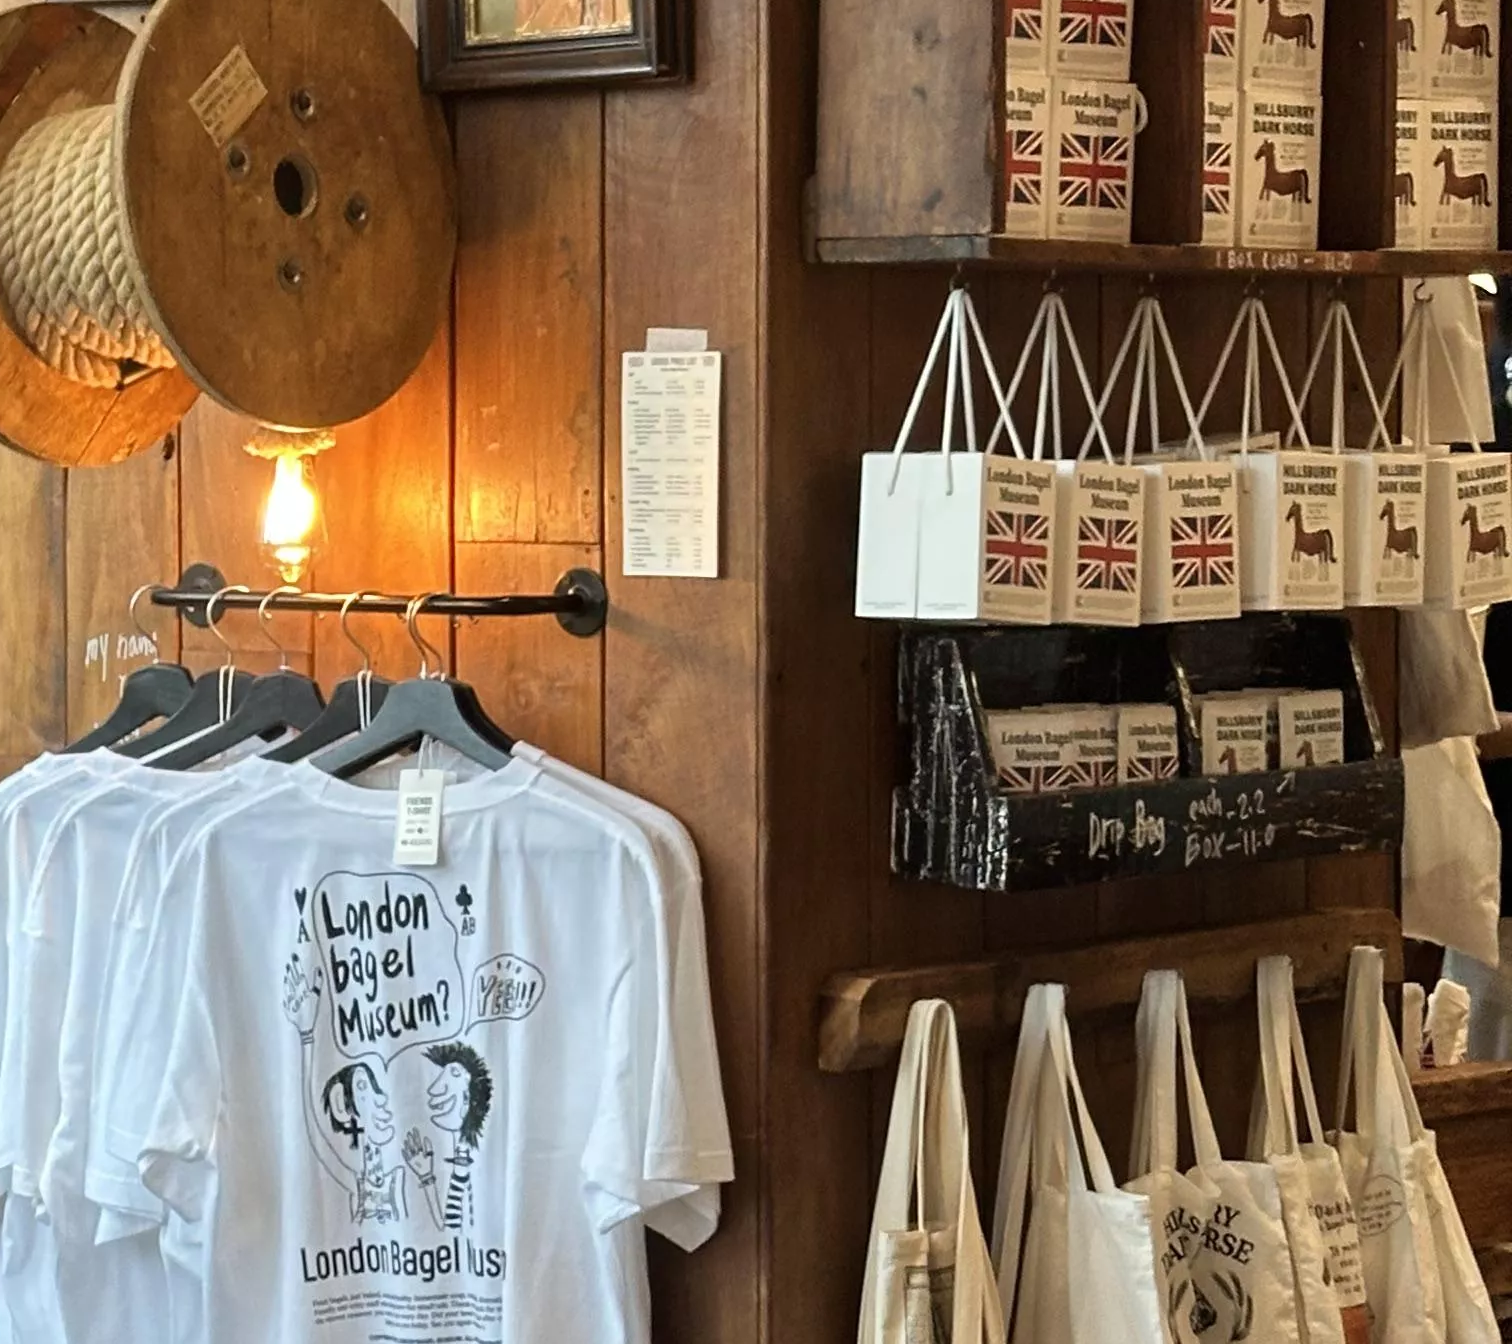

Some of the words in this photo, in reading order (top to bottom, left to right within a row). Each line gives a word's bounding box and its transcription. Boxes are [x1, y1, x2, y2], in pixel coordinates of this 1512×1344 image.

[1061, 90, 1101, 107] London
[1103, 93, 1131, 113] Bagel
[1253, 102, 1315, 118] HILLSBURRY
[1074, 109, 1118, 128] Museum
[1253, 120, 1281, 135] DARK
[1283, 122, 1315, 137] HORSE
[987, 466, 1023, 486] London
[1025, 471, 1051, 492] Bagel
[1079, 474, 1114, 492] London
[1115, 477, 1140, 496] Bagel
[1167, 475, 1205, 491] London
[1206, 472, 1232, 493] Bagel
[999, 486, 1040, 506] Museum
[1283, 482, 1305, 496] DARK
[1307, 482, 1337, 497] HORSE
[1457, 484, 1480, 500] DARK
[1481, 480, 1508, 497] HORSE
[1090, 492, 1129, 511] Museum
[1180, 493, 1221, 508] Museum
[321, 881, 429, 940] London
[297, 918, 311, 944] A
[461, 917, 477, 936] AB
[330, 935, 415, 1002] bagel
[338, 980, 449, 1046] Museum?
[300, 1237, 388, 1282] London
[390, 1236, 460, 1282] Bagel
